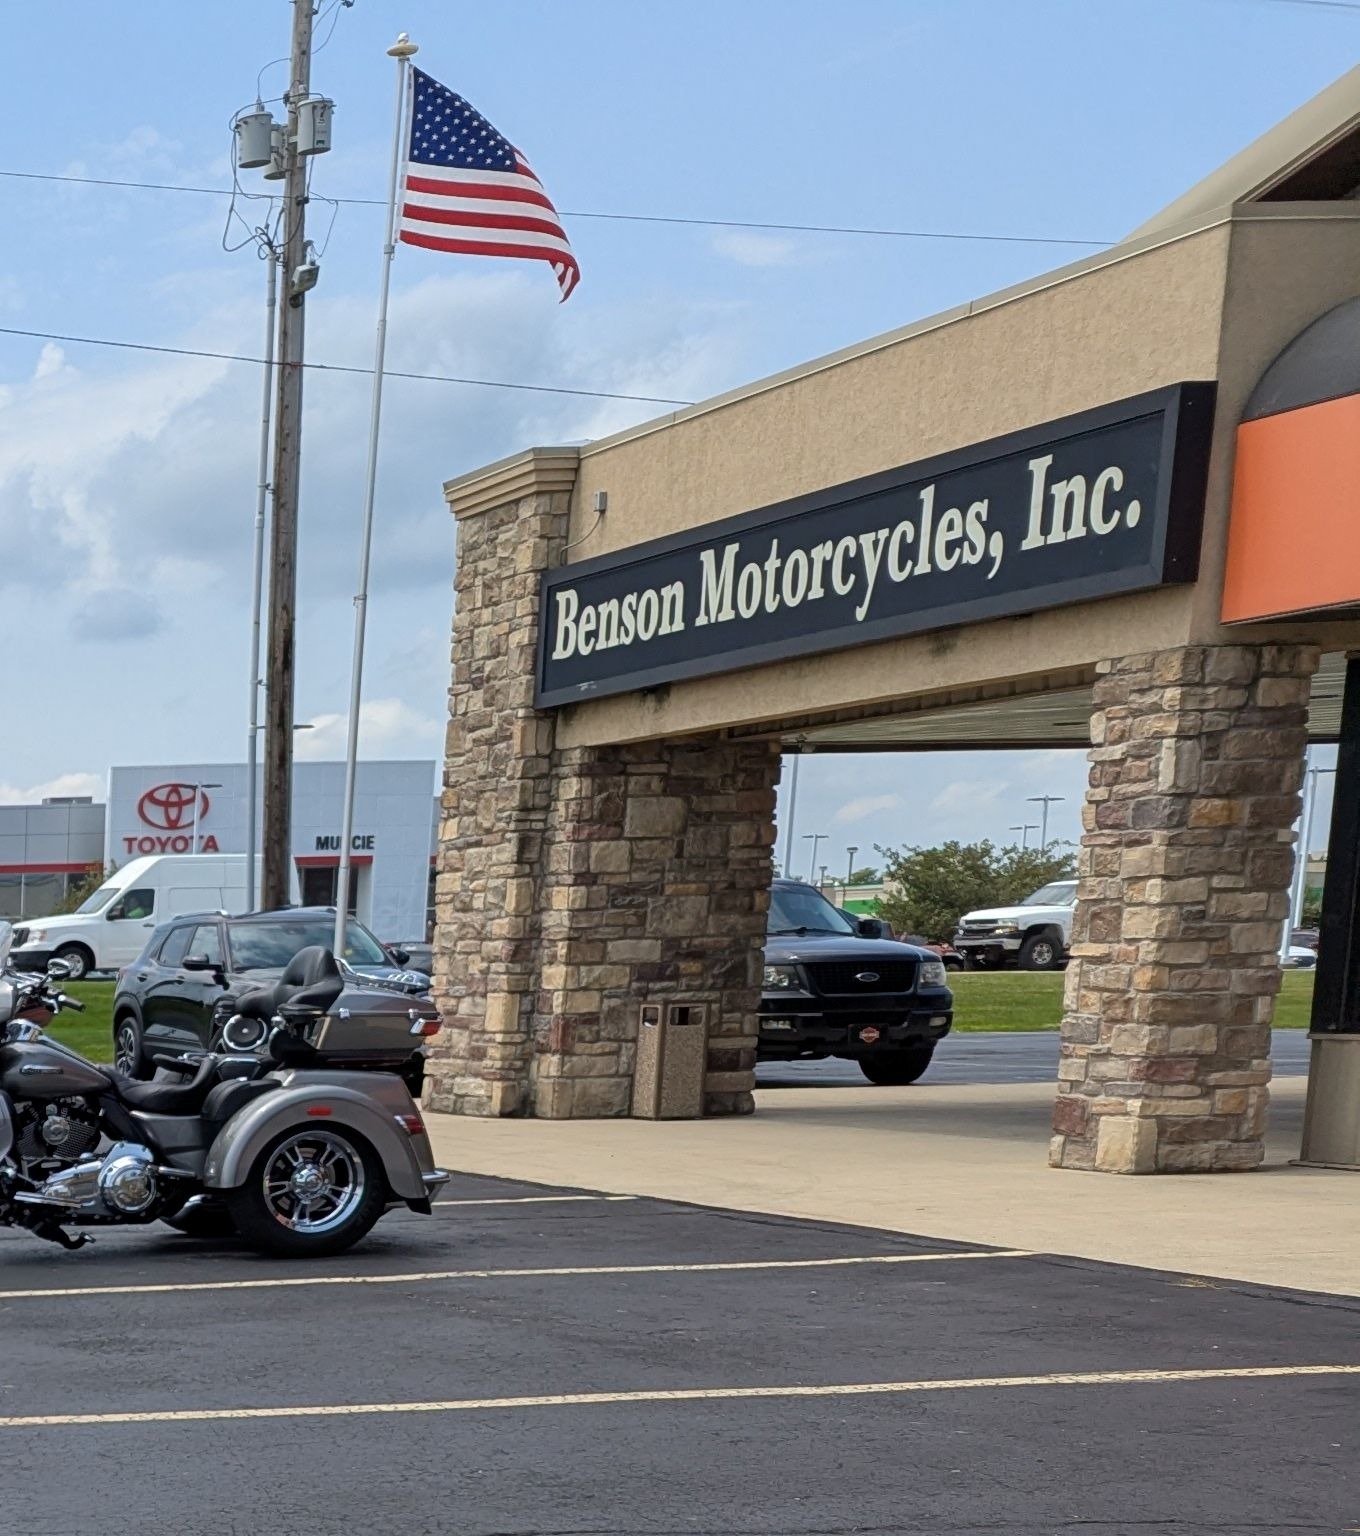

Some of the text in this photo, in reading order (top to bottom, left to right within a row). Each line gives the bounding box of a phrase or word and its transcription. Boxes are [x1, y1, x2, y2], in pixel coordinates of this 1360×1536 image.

[551, 454, 1142, 661] Benson Motorcycles, Inc.
[315, 835, 375, 851] MUCIE
